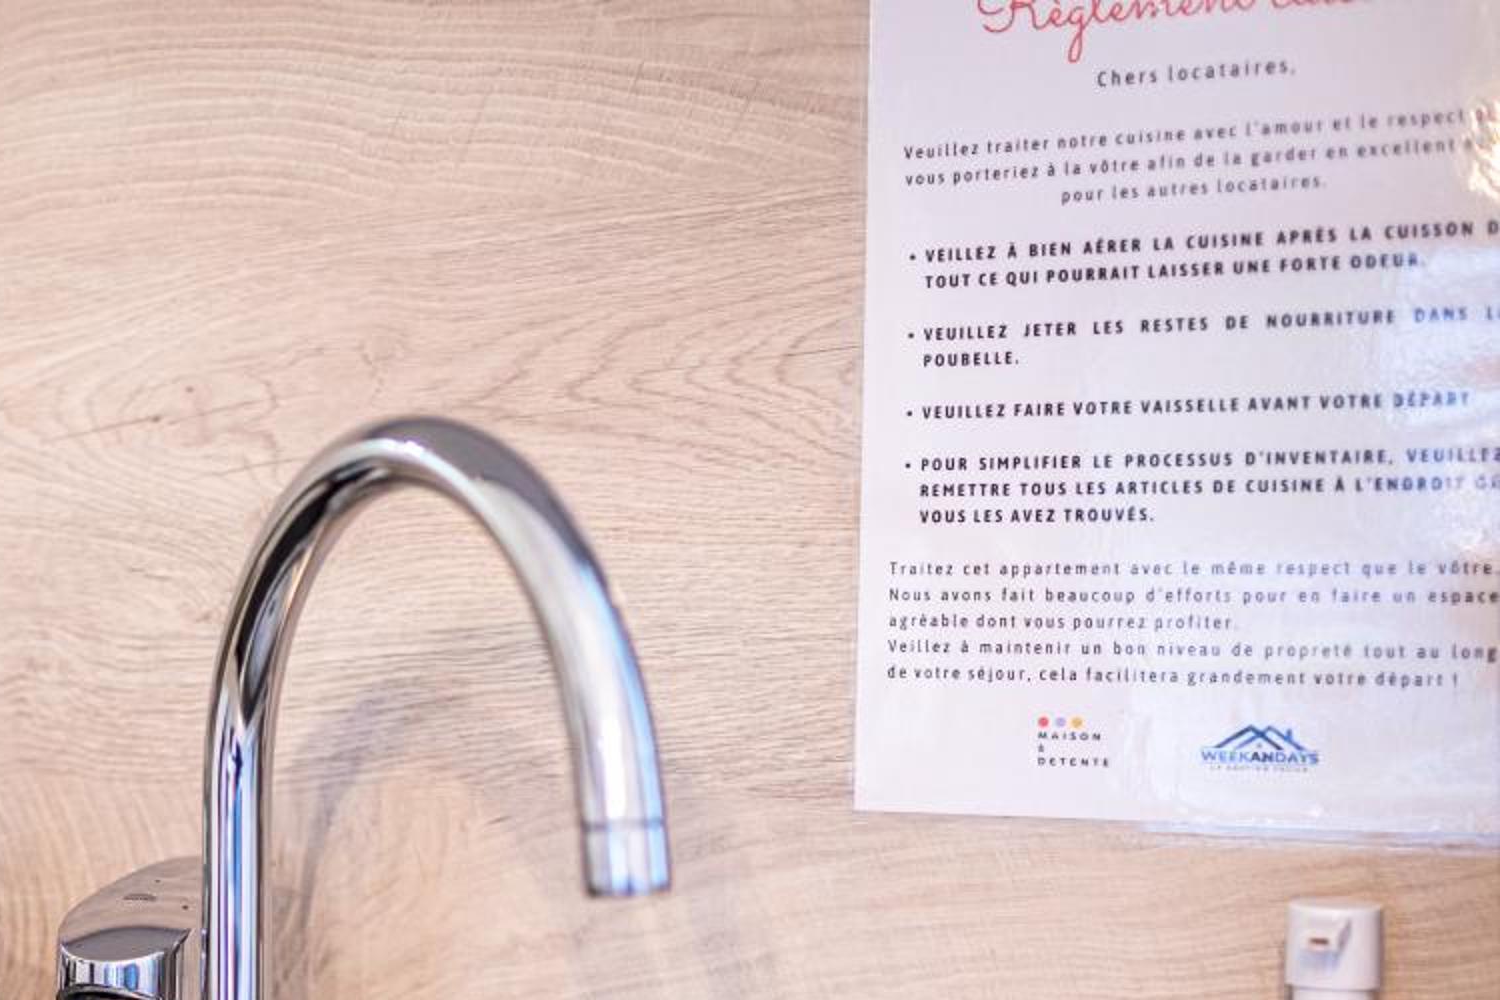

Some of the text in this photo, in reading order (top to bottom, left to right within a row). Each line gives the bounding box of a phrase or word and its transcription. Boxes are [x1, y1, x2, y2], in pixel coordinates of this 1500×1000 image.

[1097, 59, 1296, 87] Chers locataires,
[903, 141, 979, 160] Veuillez
[986, 137, 1050, 154] traiter
[1057, 133, 1107, 149] notre
[1114, 128, 1186, 146] cuisine
[1193, 125, 1237, 140] avec
[1245, 118, 1323, 137] l'amour
[1332, 115, 1351, 131] et
[1360, 114, 1378, 129] le
[1386, 107, 1465, 128] respect
[904, 172, 945, 186] vous
[952, 165, 1039, 186] porteriez
[1046, 162, 1055, 177] à
[1064, 161, 1081, 175] la
[1089, 158, 1140, 174] vôtre
[1147, 155, 1186, 171] afin
[1193, 152, 1215, 167] de
[1223, 150, 1242, 165] la
[1250, 147, 1317, 167] garder
[1325, 143, 1348, 159] en
[1357, 138, 1456, 158] excellent
[1061, 188, 1104, 205] pour
[1111, 185, 1139, 199] les
[1147, 181, 1209, 198] autres
[925, 245, 997, 263] VEILLEZ
[1007, 242, 1018, 258] À
[1029, 241, 1071, 257] BIEN
[1083, 237, 1142, 254] AÉRER
[1153, 236, 1175, 251] LA
[1186, 231, 1264, 250] CUISINE
[1276, 226, 1338, 244] APRÈS
[1349, 225, 1372, 241] LA
[1384, 221, 1474, 240] CUISSON
[925, 273, 972, 289] TOUT
[978, 271, 998, 287] CE
[1005, 270, 1038, 287] QUI
[1046, 264, 1140, 284] POURRAIT
[1148, 261, 1224, 279] LAISSER
[1233, 258, 1271, 275] UNE
[1279, 254, 1341, 272] FORTE
[923, 324, 1008, 342] VEUILLEZ
[1023, 321, 1077, 338] JETER
[1092, 319, 1124, 335] LES
[1140, 316, 1208, 333] RESTES
[1225, 314, 1249, 330] DE
[1265, 308, 1396, 329] NOURRITURE
[1414, 306, 1468, 323] DANS
[923, 350, 1019, 368] POUBELLE.
[922, 403, 1006, 419] VEUILLEZ
[1013, 401, 1065, 417] FAIRE
[1073, 400, 1133, 416] VOTRE
[1141, 397, 1240, 415] VAISSELLE
[1247, 394, 1309, 412] AVANT
[1319, 392, 1383, 410] VOTRE
[920, 447, 1500, 471] POUR SIMPLIFIER LE PROCESSUS D'INVENTAIRE, VEUILLEZ
[919, 483, 1011, 497] REMETTRE
[1020, 481, 1067, 496] TOUS
[1075, 480, 1106, 495] LES
[1115, 478, 1203, 495] ARTICLES
[1213, 478, 1236, 493] DE
[1245, 477, 1325, 493] CUISINE
[1334, 475, 1345, 492] À
[1355, 475, 1464, 492] L'ENDROIT
[920, 505, 1154, 524] VOUS LES AVEZ TROUVÉS.
[889, 561, 953, 576] Traitez
[963, 562, 990, 576] cet
[999, 562, 1120, 578] appartement
[1130, 564, 1173, 576] avec
[1182, 561, 1200, 575] le
[1211, 561, 1265, 575] même
[1276, 561, 1351, 577] respect
[1361, 563, 1397, 577] que
[1408, 561, 1427, 575] le
[888, 587, 1499, 606] Nous avons fait beaucoup d'efforts pour en faire un espace
[889, 613, 969, 630] agréable
[976, 614, 1017, 628] dont
[1024, 617, 1066, 629] vous
[1073, 617, 1146, 631] pourrez
[888, 639, 1498, 663] Veillez à maintenir un bon niveau de propreté tout au long
[887, 666, 907, 679] de
[913, 667, 960, 680] votre
[968, 667, 1032, 683] séjour,
[1039, 667, 1078, 681] cela
[1085, 667, 1178, 683] facilitera
[1187, 670, 1305, 687] grandement
[1313, 671, 1366, 685] votre
[1375, 670, 1445, 688] départ
[1037, 731, 1101, 741] MAISON
[1200, 750, 1318, 765] WEEKANDAYS
